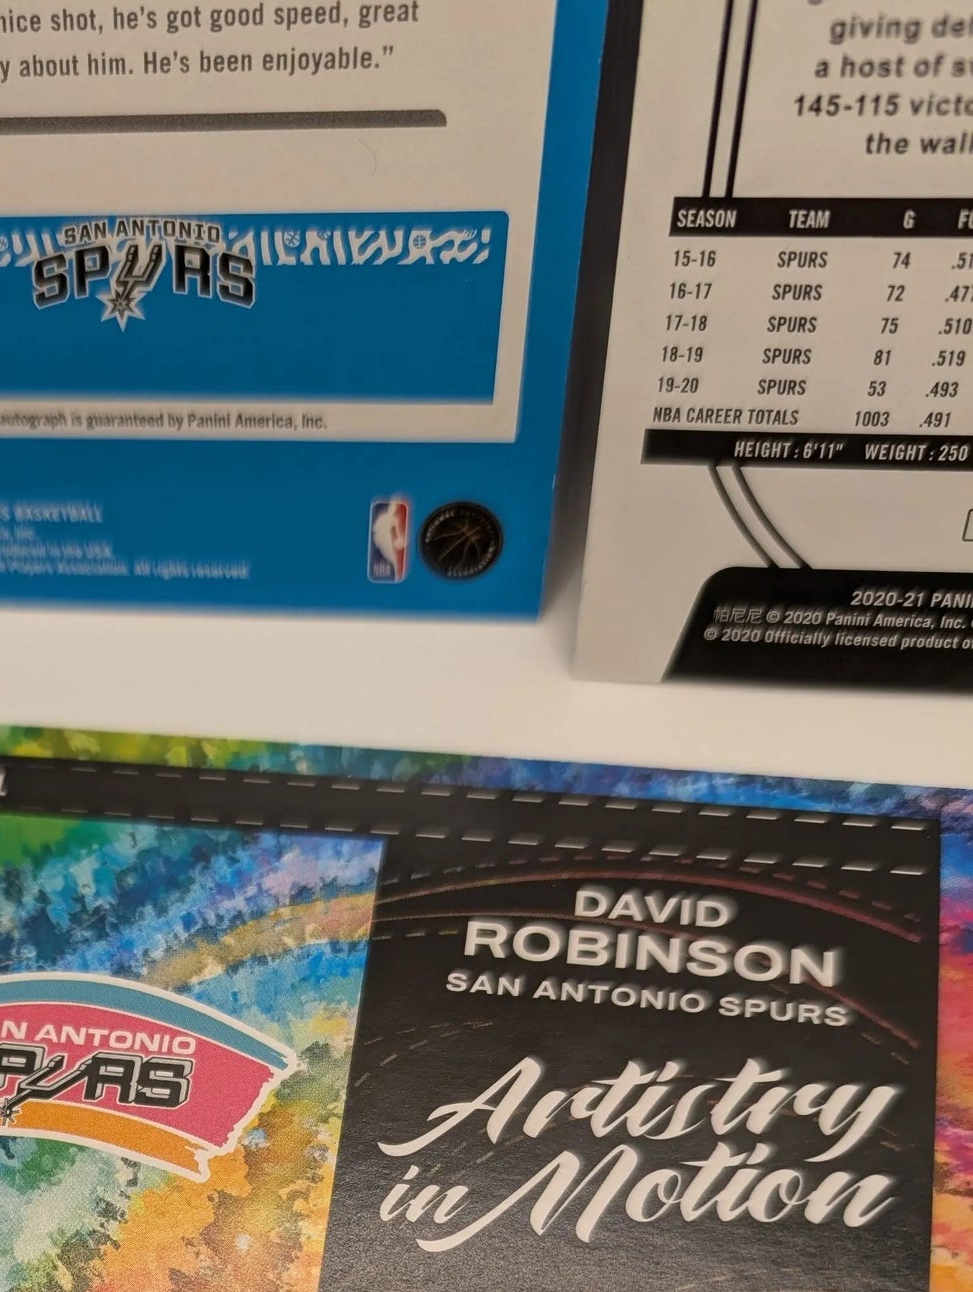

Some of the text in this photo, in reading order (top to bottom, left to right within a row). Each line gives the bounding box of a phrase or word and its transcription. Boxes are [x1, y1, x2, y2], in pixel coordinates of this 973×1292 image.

[51, 9, 103, 34] shot,
[166, 6, 201, 34] got
[210, 2, 264, 33] good
[273, 0, 349, 31] speed,
[358, 0, 419, 28] great
[829, 14, 921, 45] giving
[19, 54, 79, 78] about
[88, 52, 134, 76] him.
[200, 50, 252, 73] been
[814, 52, 945, 79] a host of
[794, 93, 899, 117] 145-115
[865, 132, 909, 155] the
[677, 209, 917, 230] SEASON TEAM G
[62, 217, 222, 246] SAN ANTONIO
[673, 250, 911, 270] 15-16 SPURS 74
[32, 243, 256, 312] SPURS
[669, 282, 905, 303] 16-17 SPURS 72
[665, 314, 899, 335] 17-18 SPURS 75
[661, 346, 966, 368] 18-19 SPURS 81 .519
[657, 377, 959, 399] 19-20 SPURS 53 .493
[0, 411, 68, 430] autograph
[72, 412, 82, 428] is
[86, 412, 164, 430] guaranteed
[168, 412, 183, 431] by
[187, 413, 231, 430] Panini
[234, 413, 298, 431] America,
[301, 414, 328, 430] Inc.
[652, 407, 952, 428] NBA CAREER TOTALS 1003 .491
[734, 440, 791, 459] HEIGHT
[864, 442, 926, 461] WEIGHT
[938, 444, 969, 462] 250
[850, 590, 924, 608] 2020-21
[825, 612, 966, 630] Panini America, Inc.
[765, 630, 958, 651] Officially licensed product
[574, 888, 737, 928] DAVID
[463, 919, 846, 988] ROBINSON
[446, 969, 853, 1027] SAN ANTONIO SPURS
[35, 1024, 197, 1055] ANTONIO
[376, 1056, 903, 1163] Artistry
[379, 1141, 901, 1252] in Motion
